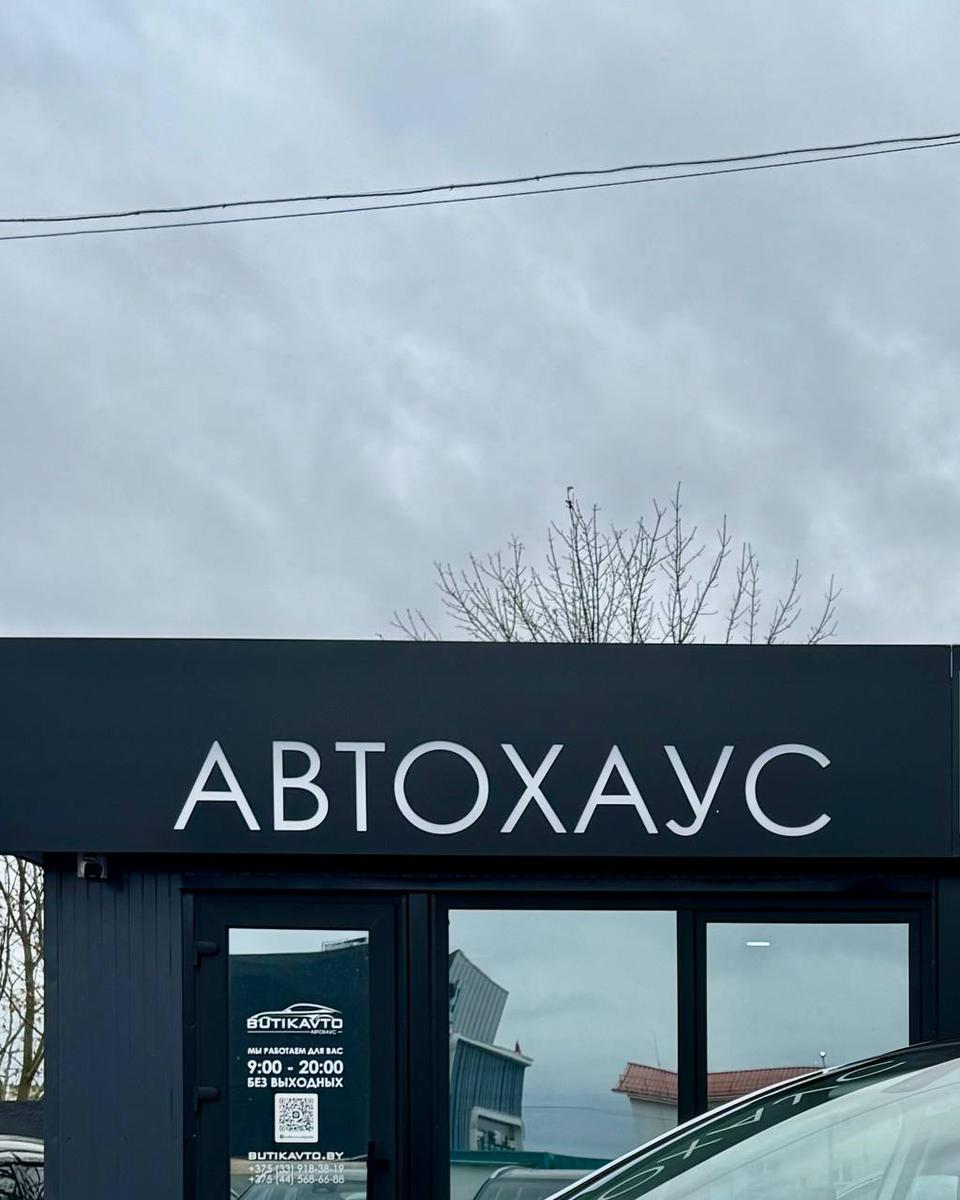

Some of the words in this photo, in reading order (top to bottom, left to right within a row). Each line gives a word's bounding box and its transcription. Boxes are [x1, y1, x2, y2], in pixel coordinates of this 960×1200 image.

[174, 740, 831, 837] АВТОХАУС
[247, 1017, 343, 1029] BUTIKAVTO
[247, 1047, 262, 1055] МЫ
[263, 1047, 306, 1055] РАБОТАЕМ
[307, 1047, 324, 1055] ДЛЯ
[326, 1047, 344, 1055] ВАС
[247, 1059, 282, 1074] 9:00
[298, 1059, 344, 1074] 20:00
[247, 1077, 267, 1088] БЕЗ
[271, 1077, 343, 1089] ВЫХОДНЫХ
[248, 1151, 344, 1160] BUTIKAVTO.BY
[248, 1164, 273, 1174] +375
[275, 1164, 294, 1176] (33)
[248, 1174, 273, 1184] +375
[275, 1174, 294, 1186] (44)
